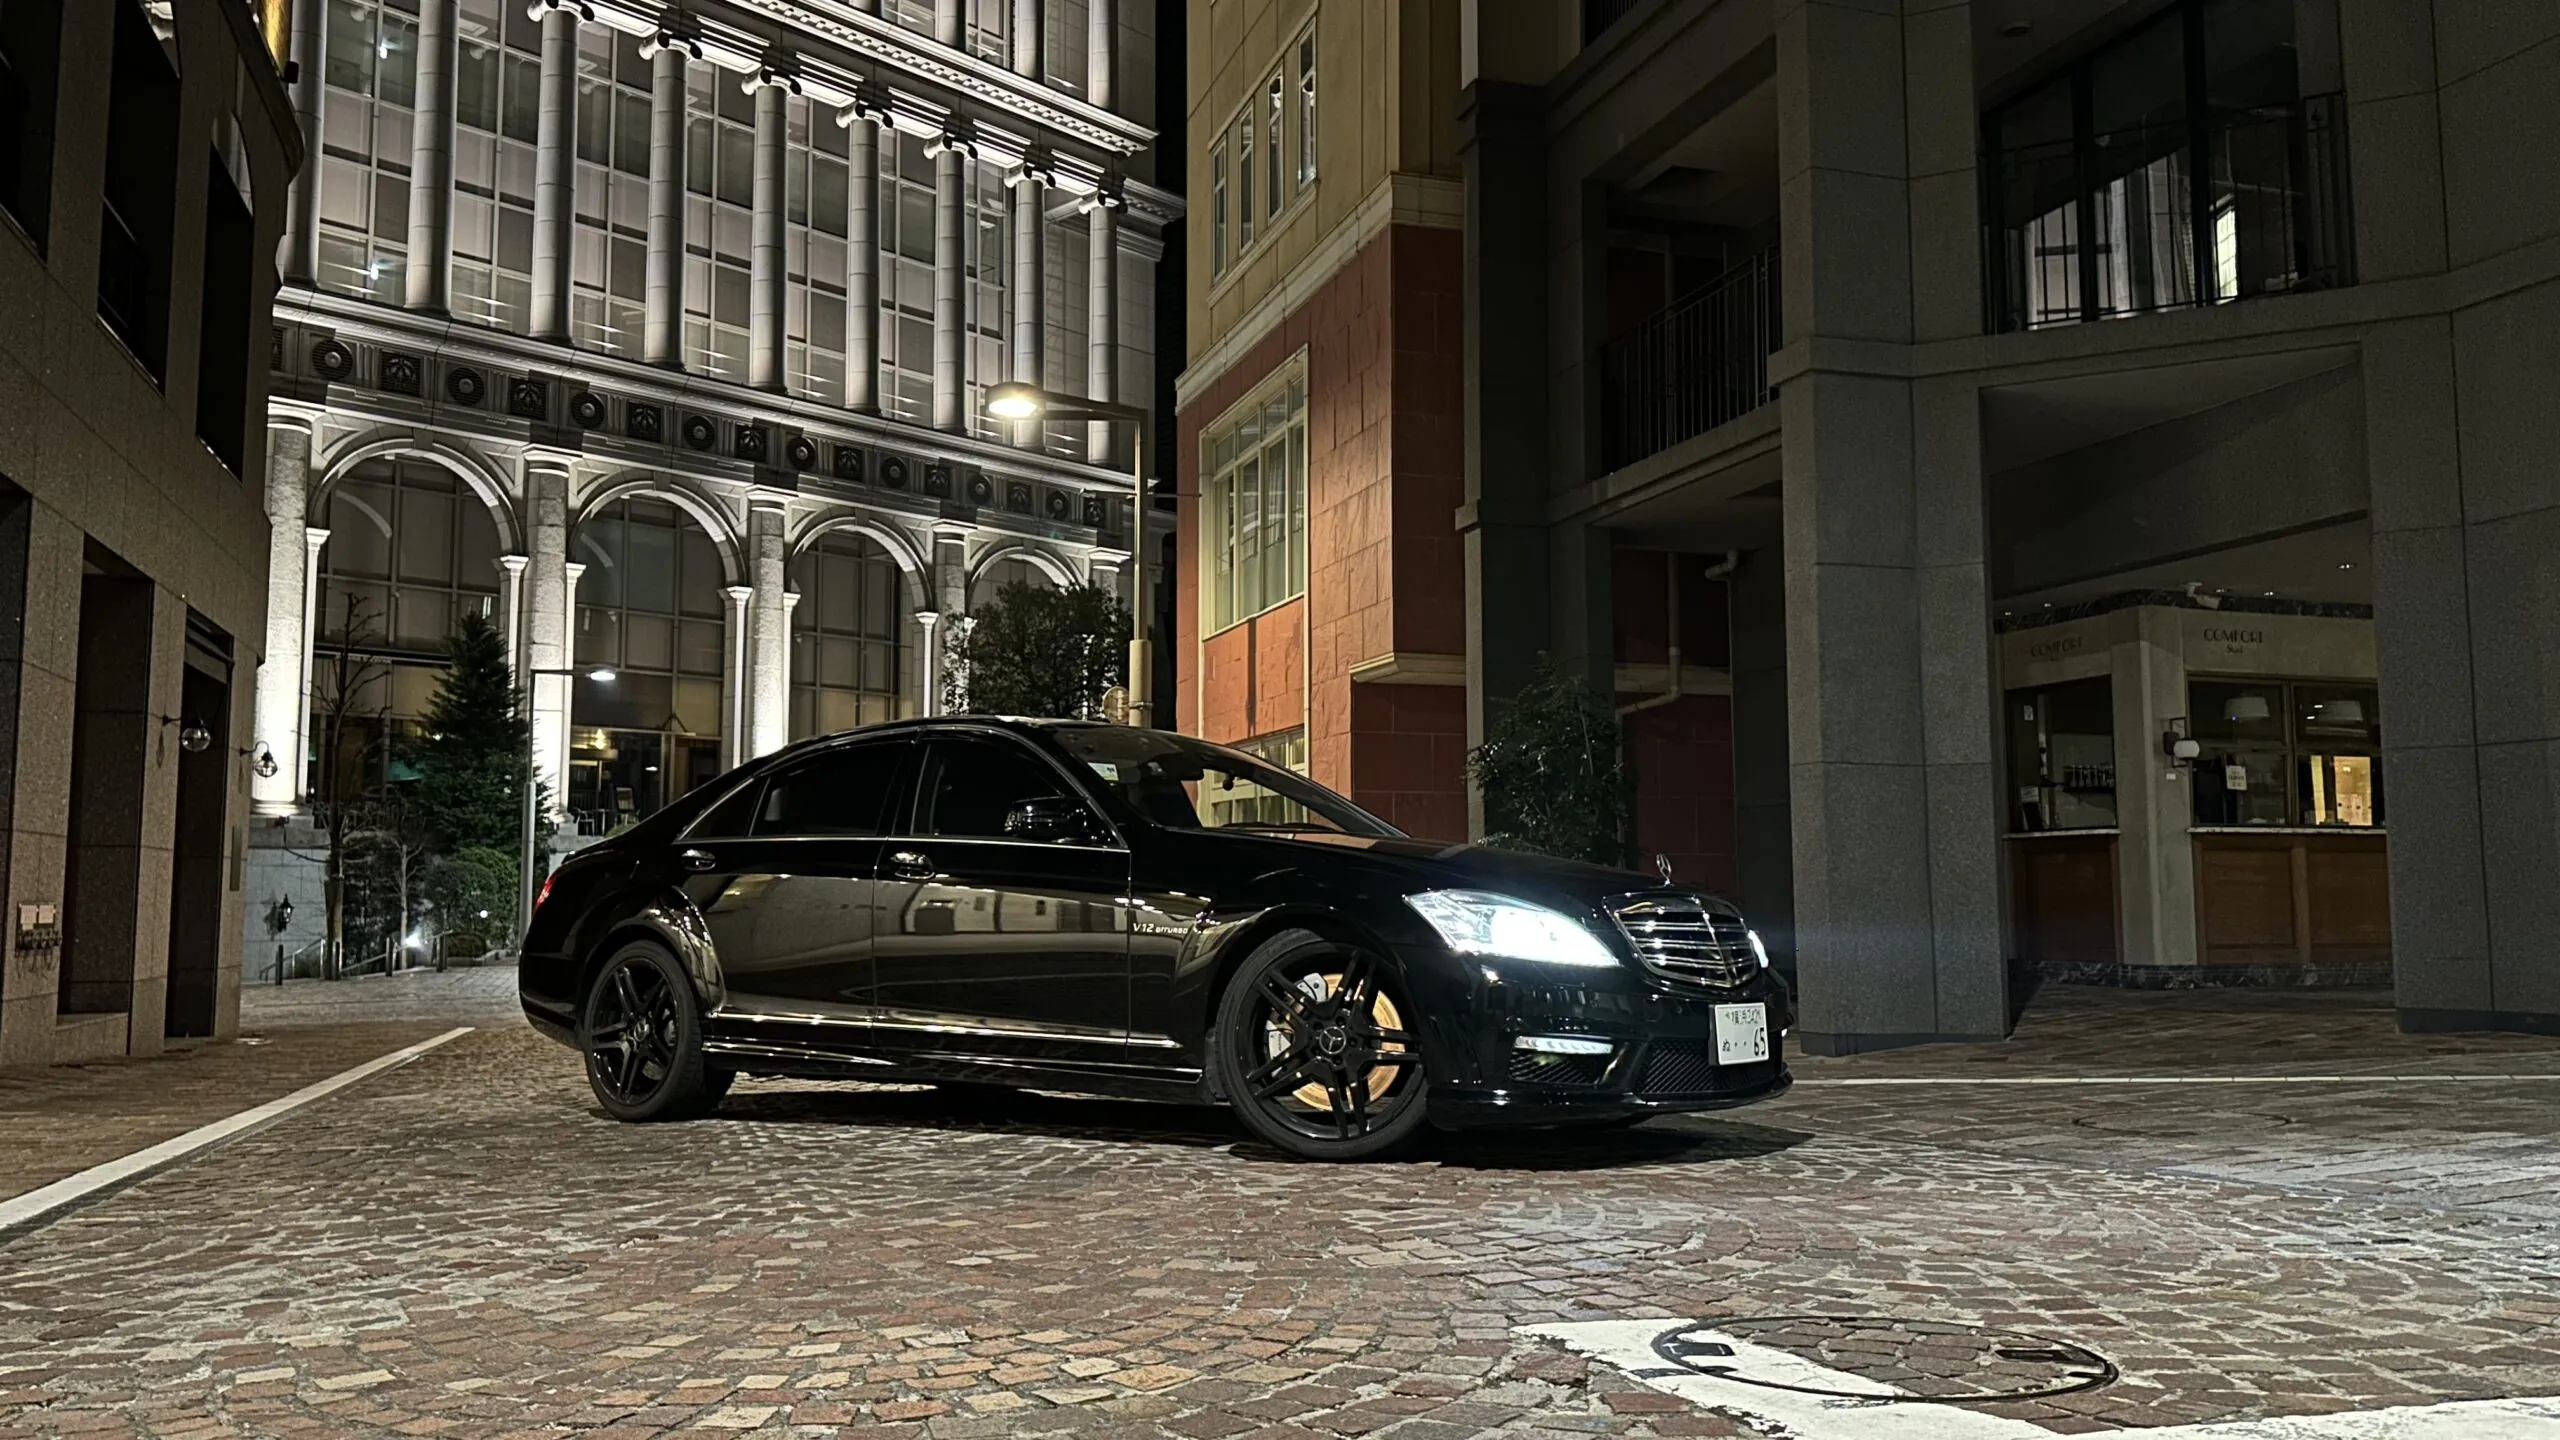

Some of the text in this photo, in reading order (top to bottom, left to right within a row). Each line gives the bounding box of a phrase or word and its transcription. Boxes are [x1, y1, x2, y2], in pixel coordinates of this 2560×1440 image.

[2203, 628, 2263, 644] COMFORT
[2030, 636, 2084, 656] COMFORT
[1133, 923, 1154, 932] V12
